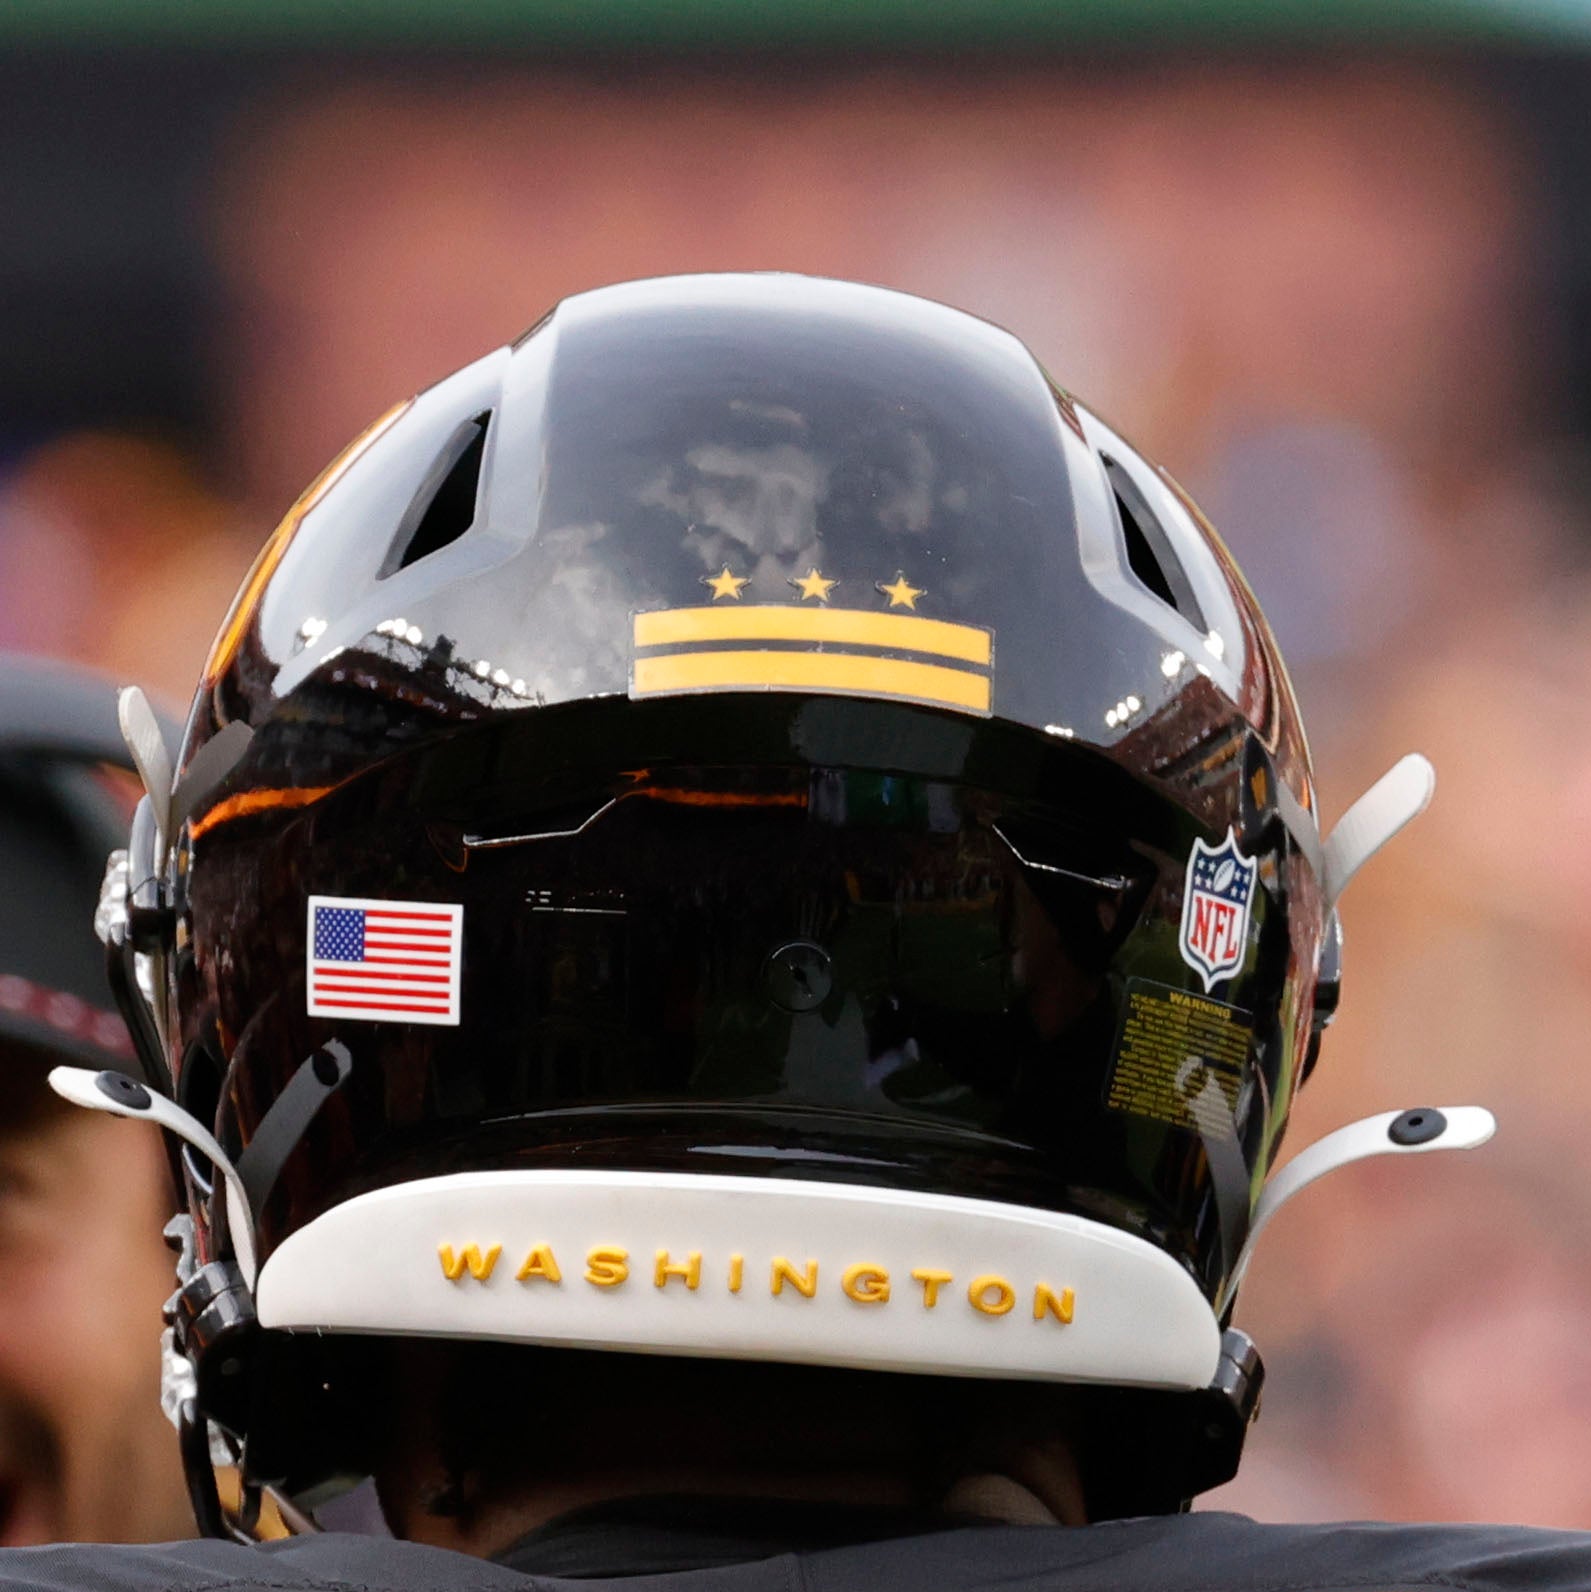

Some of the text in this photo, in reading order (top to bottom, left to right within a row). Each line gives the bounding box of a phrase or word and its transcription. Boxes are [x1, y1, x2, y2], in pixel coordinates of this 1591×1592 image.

[1190, 896, 1239, 963] NFL
[1169, 991, 1232, 1020] WARNING
[437, 1243, 1075, 1325] WASHINGTON
